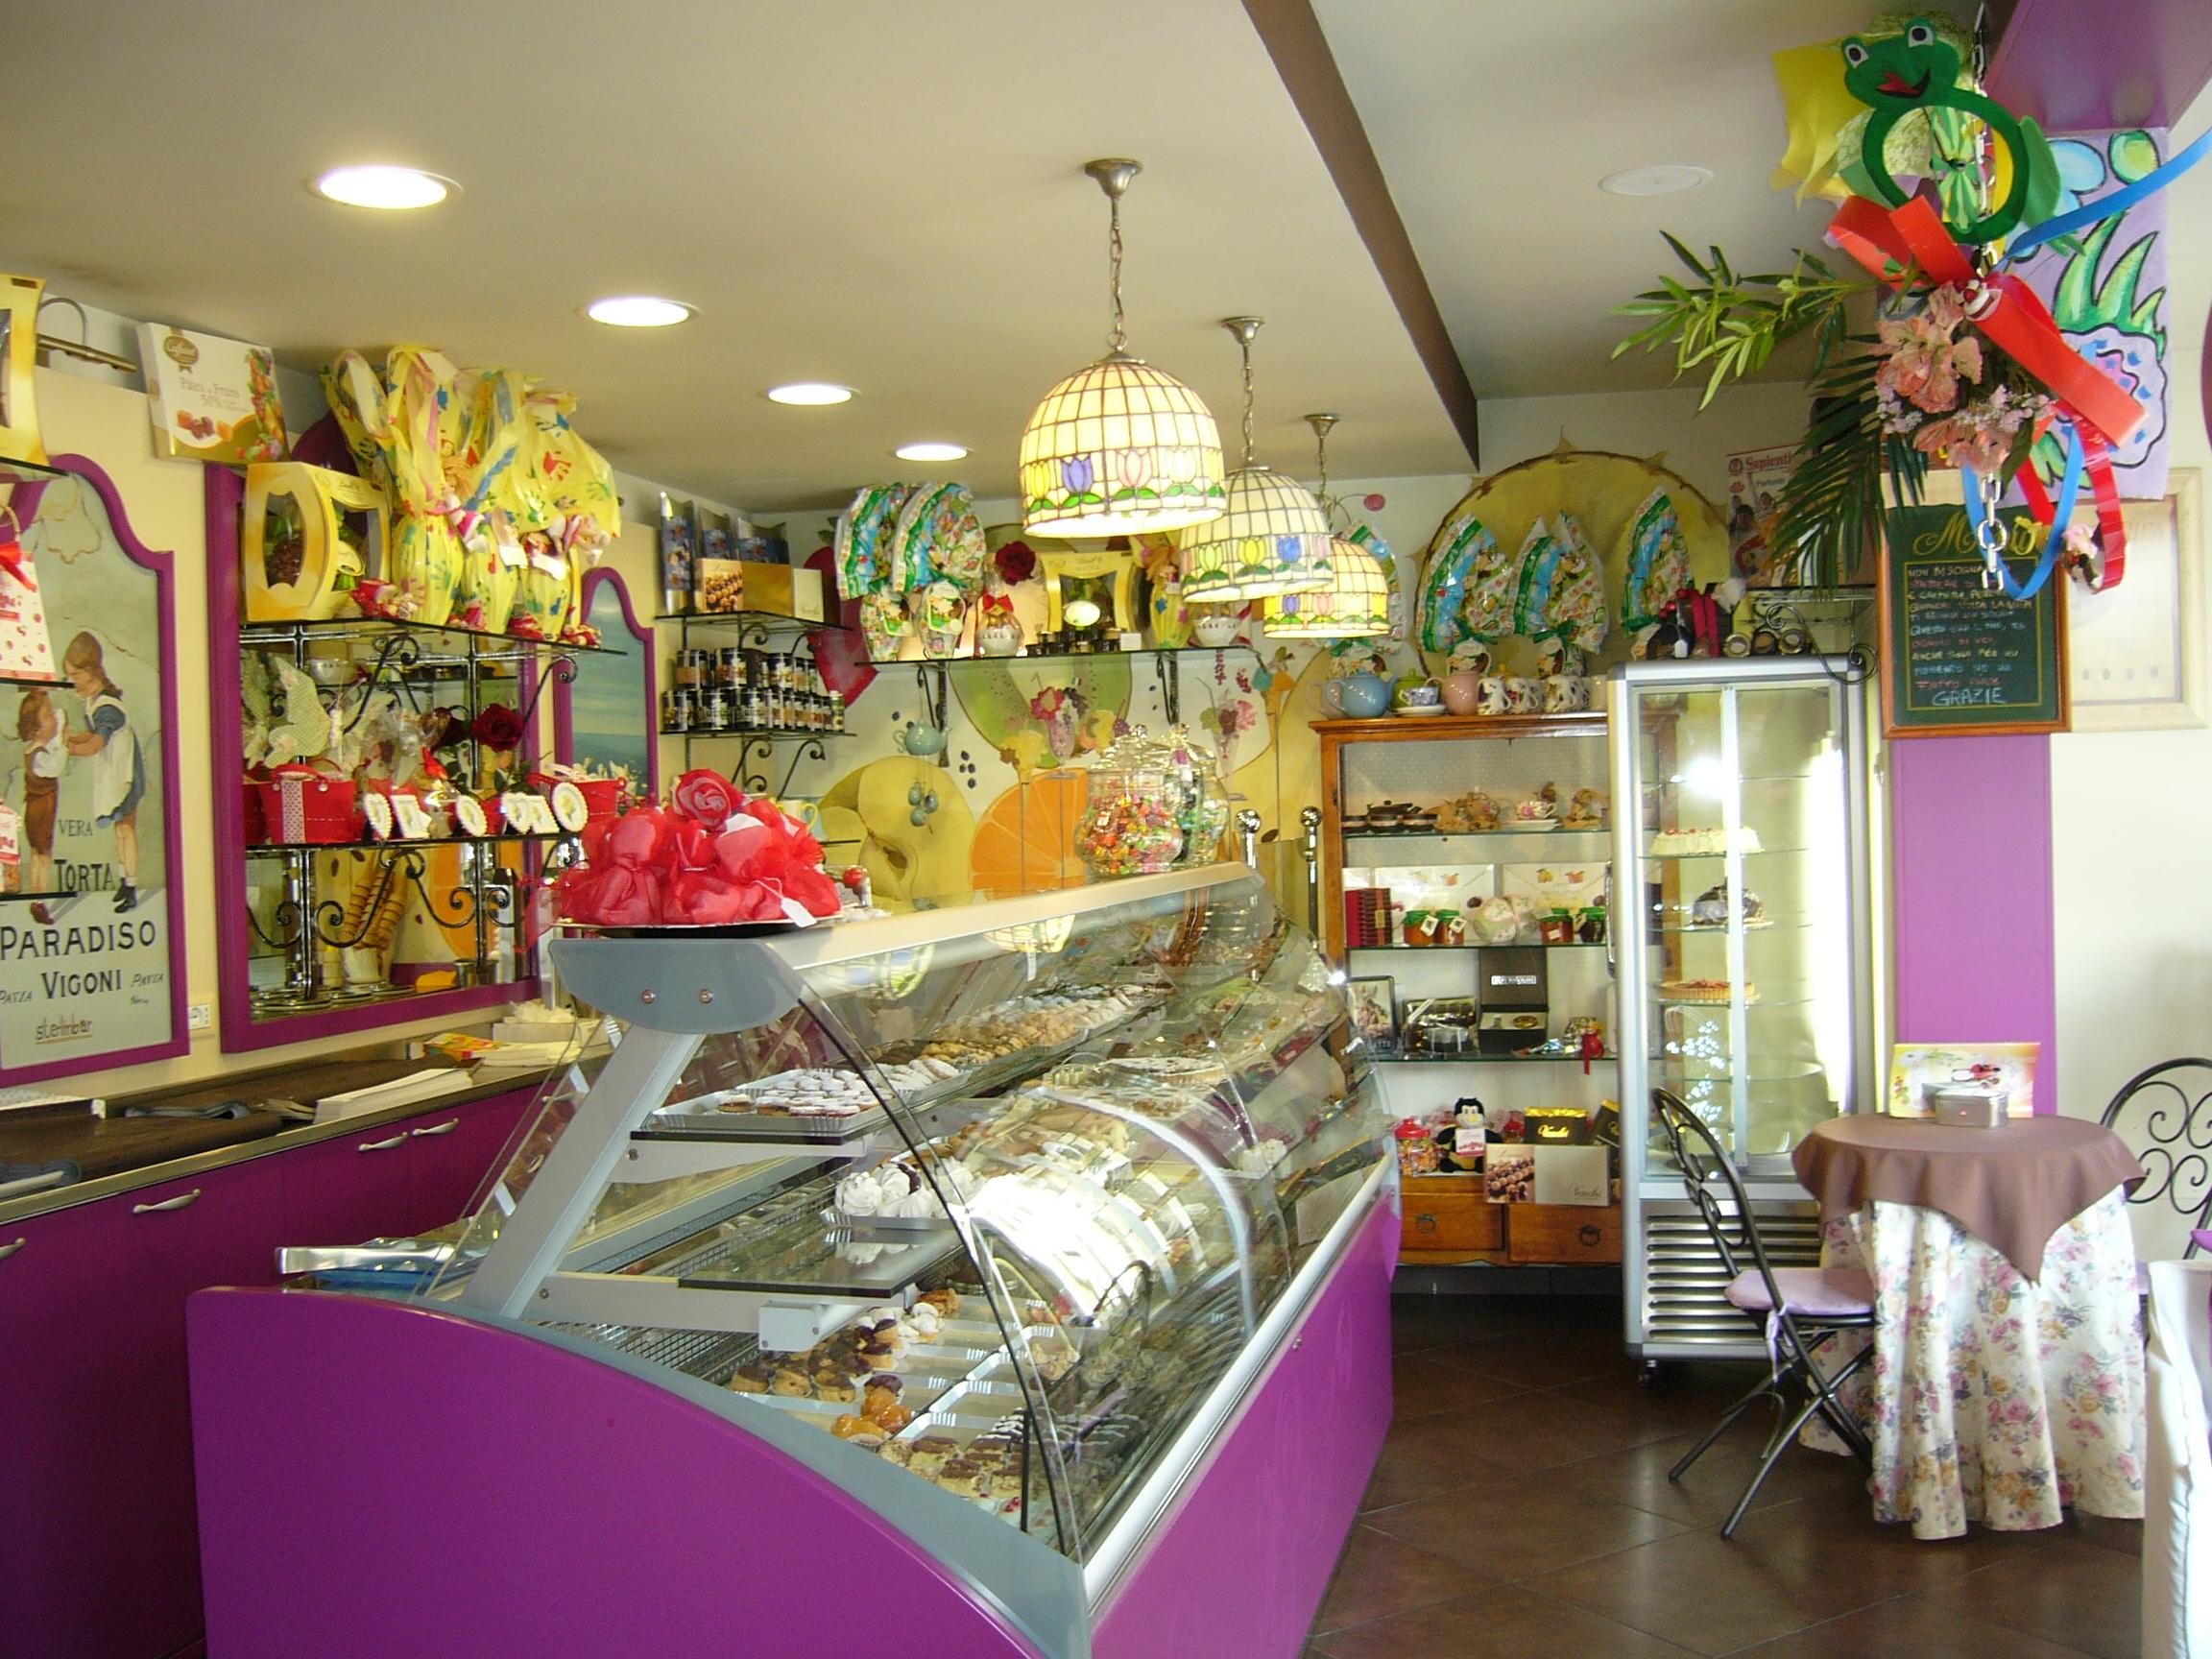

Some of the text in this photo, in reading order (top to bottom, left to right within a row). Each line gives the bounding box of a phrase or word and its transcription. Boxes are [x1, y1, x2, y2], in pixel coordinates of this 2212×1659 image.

[1932, 686, 2008, 707] GRAZIE
[59, 819, 93, 837] VERA
[54, 858, 116, 893] TORTA
[0, 920, 156, 960] PARADISO
[40, 969, 123, 999] VIGONI
